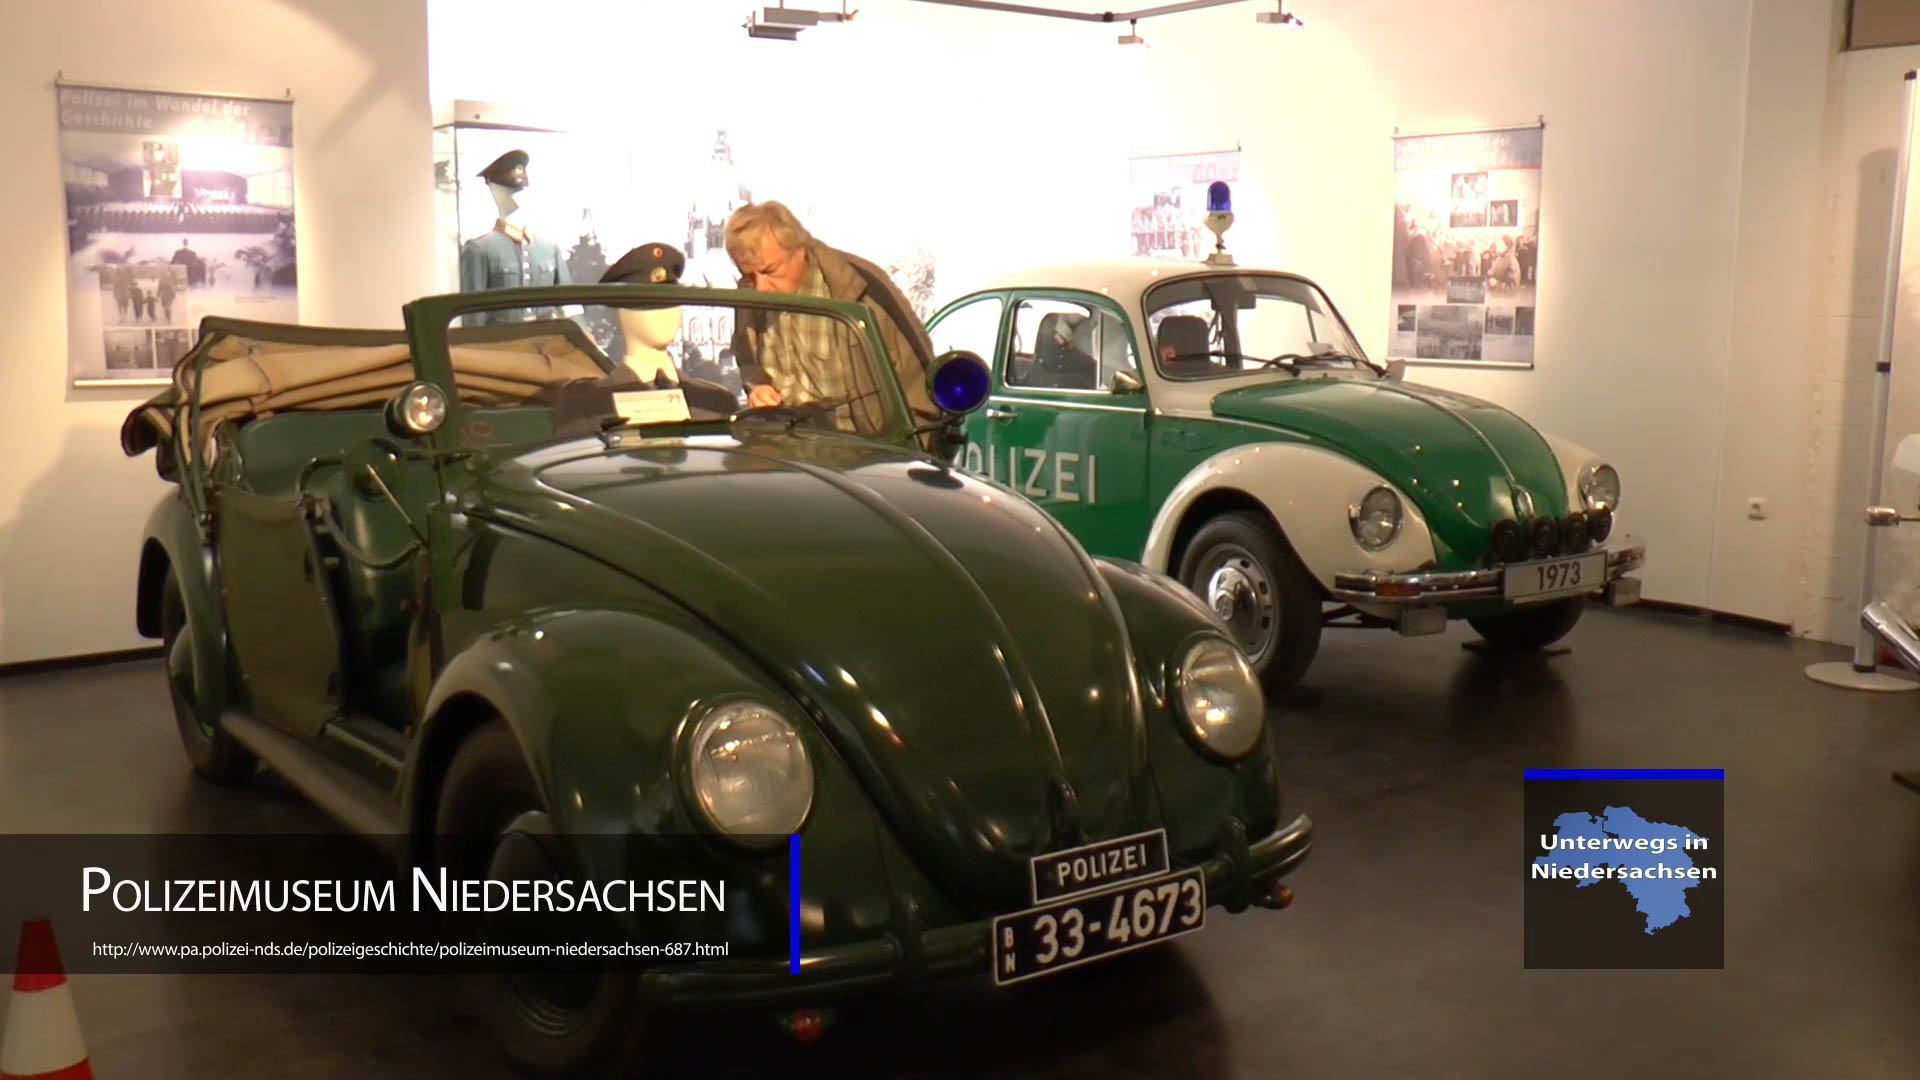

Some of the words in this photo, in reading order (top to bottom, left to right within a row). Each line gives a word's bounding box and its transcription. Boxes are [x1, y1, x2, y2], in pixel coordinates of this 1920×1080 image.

[154, 96, 217, 115] Wandel
[223, 101, 250, 117] der
[953, 442, 1096, 505] OLIZEI
[1538, 561, 1581, 590] 1973
[1057, 843, 1147, 887] POLIZEI
[1034, 878, 1200, 964] 33-4673
